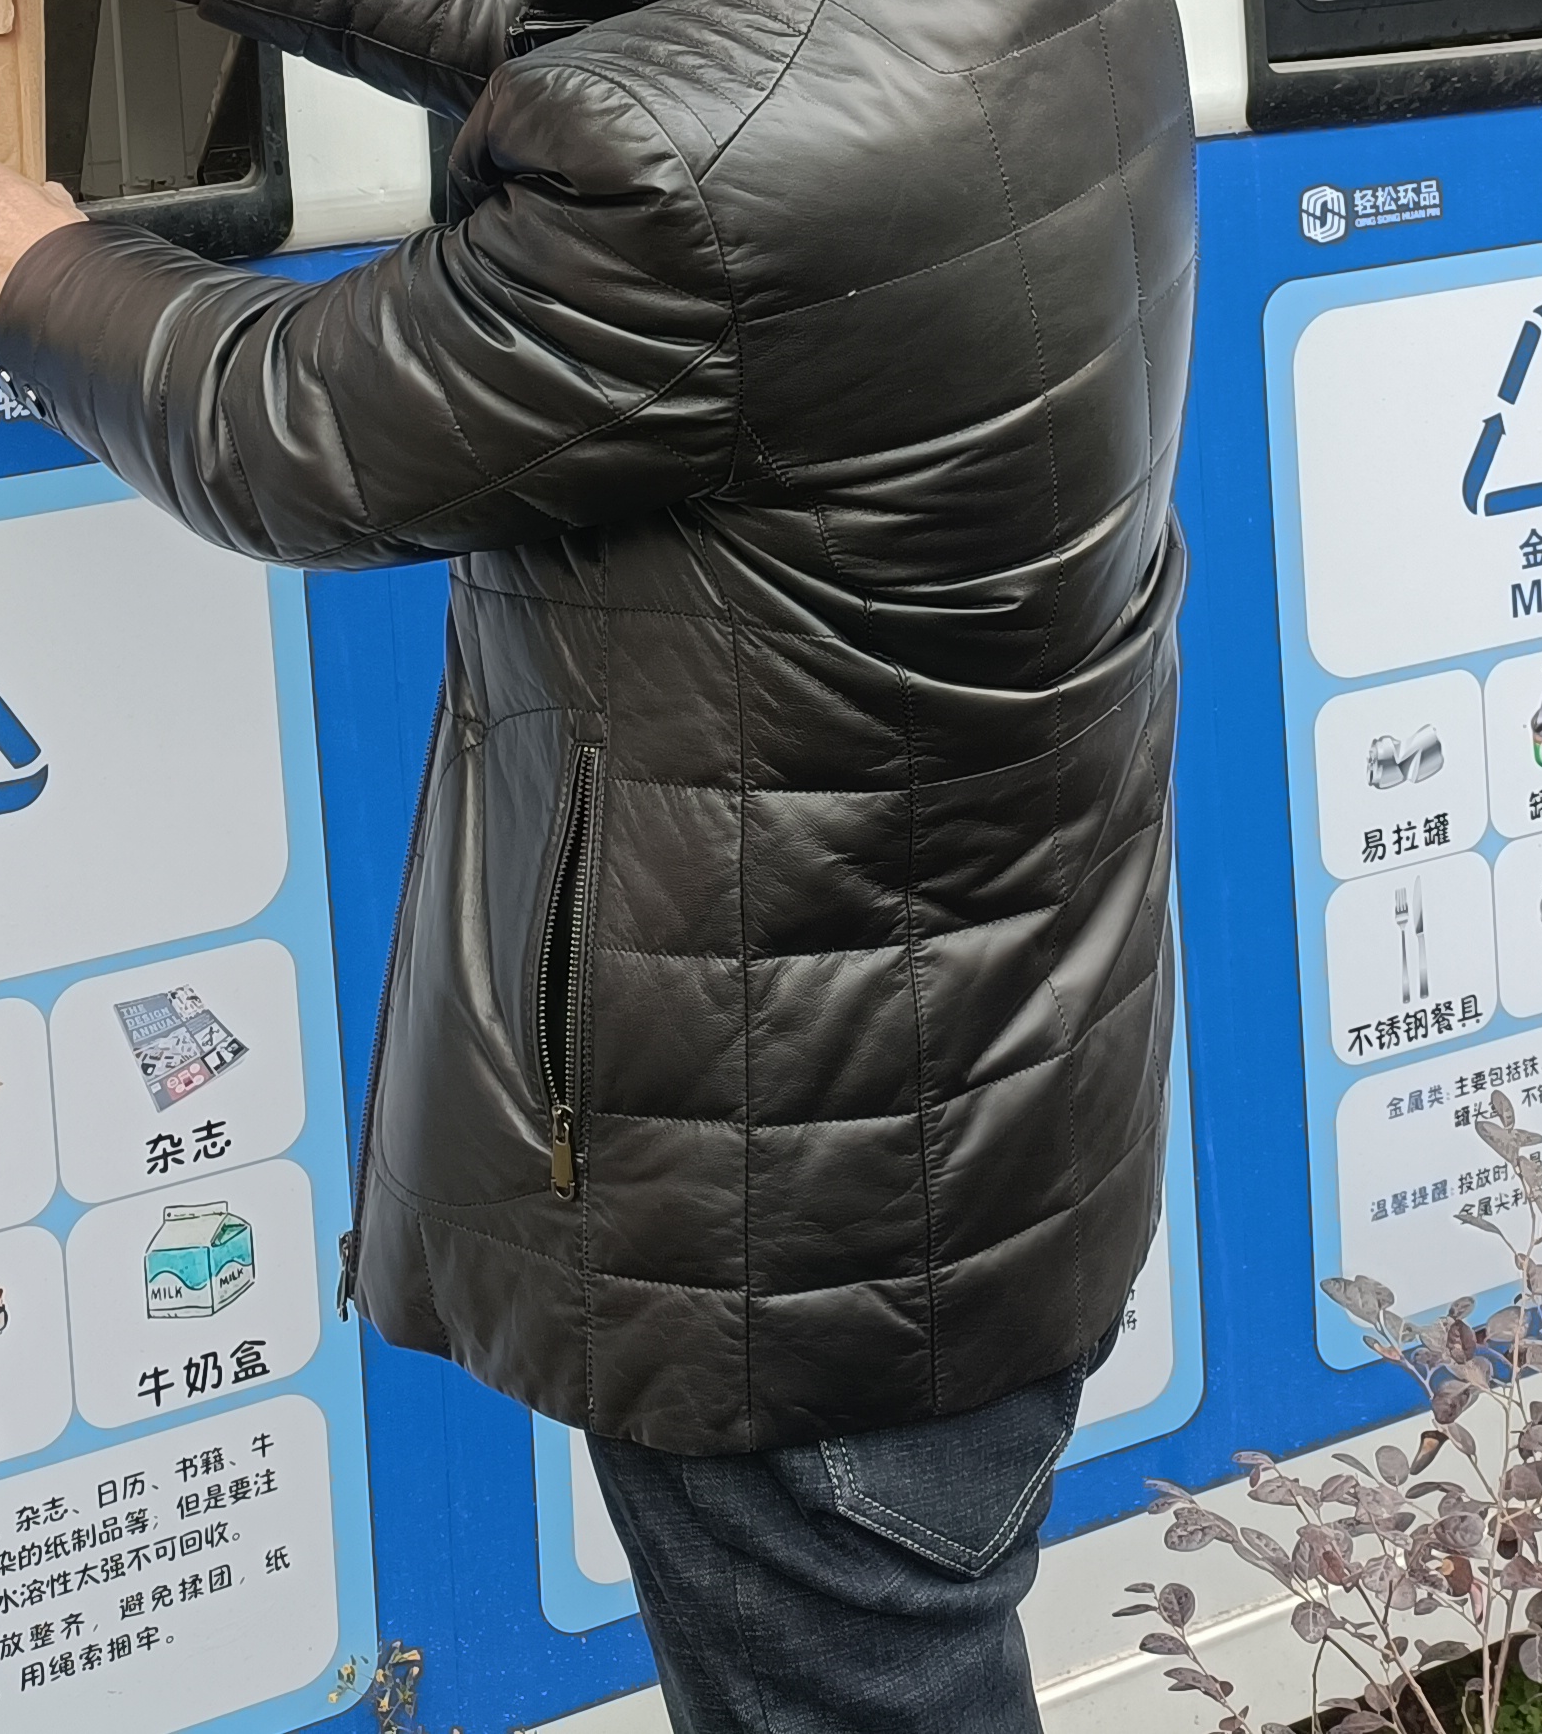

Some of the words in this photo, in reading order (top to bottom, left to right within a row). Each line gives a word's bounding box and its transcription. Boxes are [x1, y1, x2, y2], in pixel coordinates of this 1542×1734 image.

[1354, 179, 1441, 215] 轻松环品
[1361, 812, 1451, 863] 易拉罐
[1348, 994, 1484, 1057] 不锈钢餐具
[145, 1120, 233, 1175] 杂志
[151, 1286, 183, 1301] MILK
[219, 1267, 244, 1288] MILK
[137, 1339, 271, 1409] 牛奶盒
